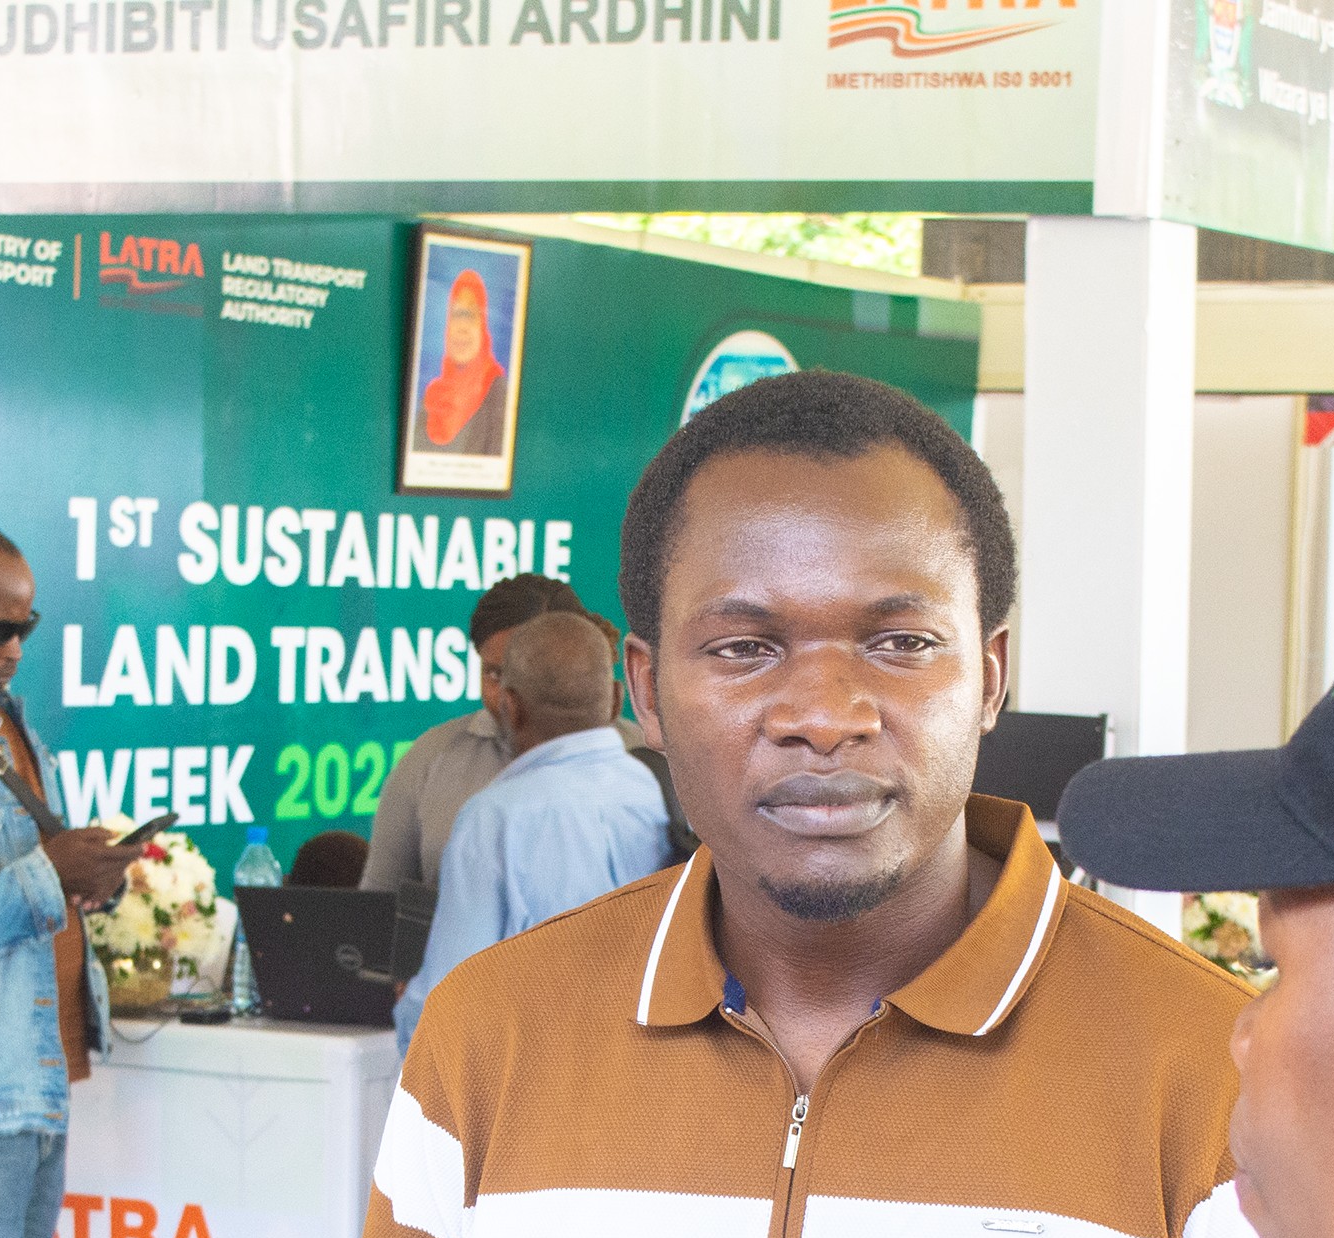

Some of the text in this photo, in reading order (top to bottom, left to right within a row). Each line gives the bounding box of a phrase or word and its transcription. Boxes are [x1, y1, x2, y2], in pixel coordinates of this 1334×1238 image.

[249, 0, 490, 51] USAFIRI
[509, 0, 784, 46] ARDHINI
[825, 72, 988, 89] IMETHIBITISHWA
[1028, 70, 1073, 88] 9001
[31, 239, 63, 263] OF
[99, 232, 205, 278] LATRA
[222, 251, 367, 290] LAND TRANSPORT
[222, 275, 330, 308] REGULATORY
[220, 300, 314, 330] AUTHORITY
[176, 497, 574, 590] SUSTAINABLE
[62, 623, 259, 708] LAND
[60, 741, 416, 826] WEEK 202
